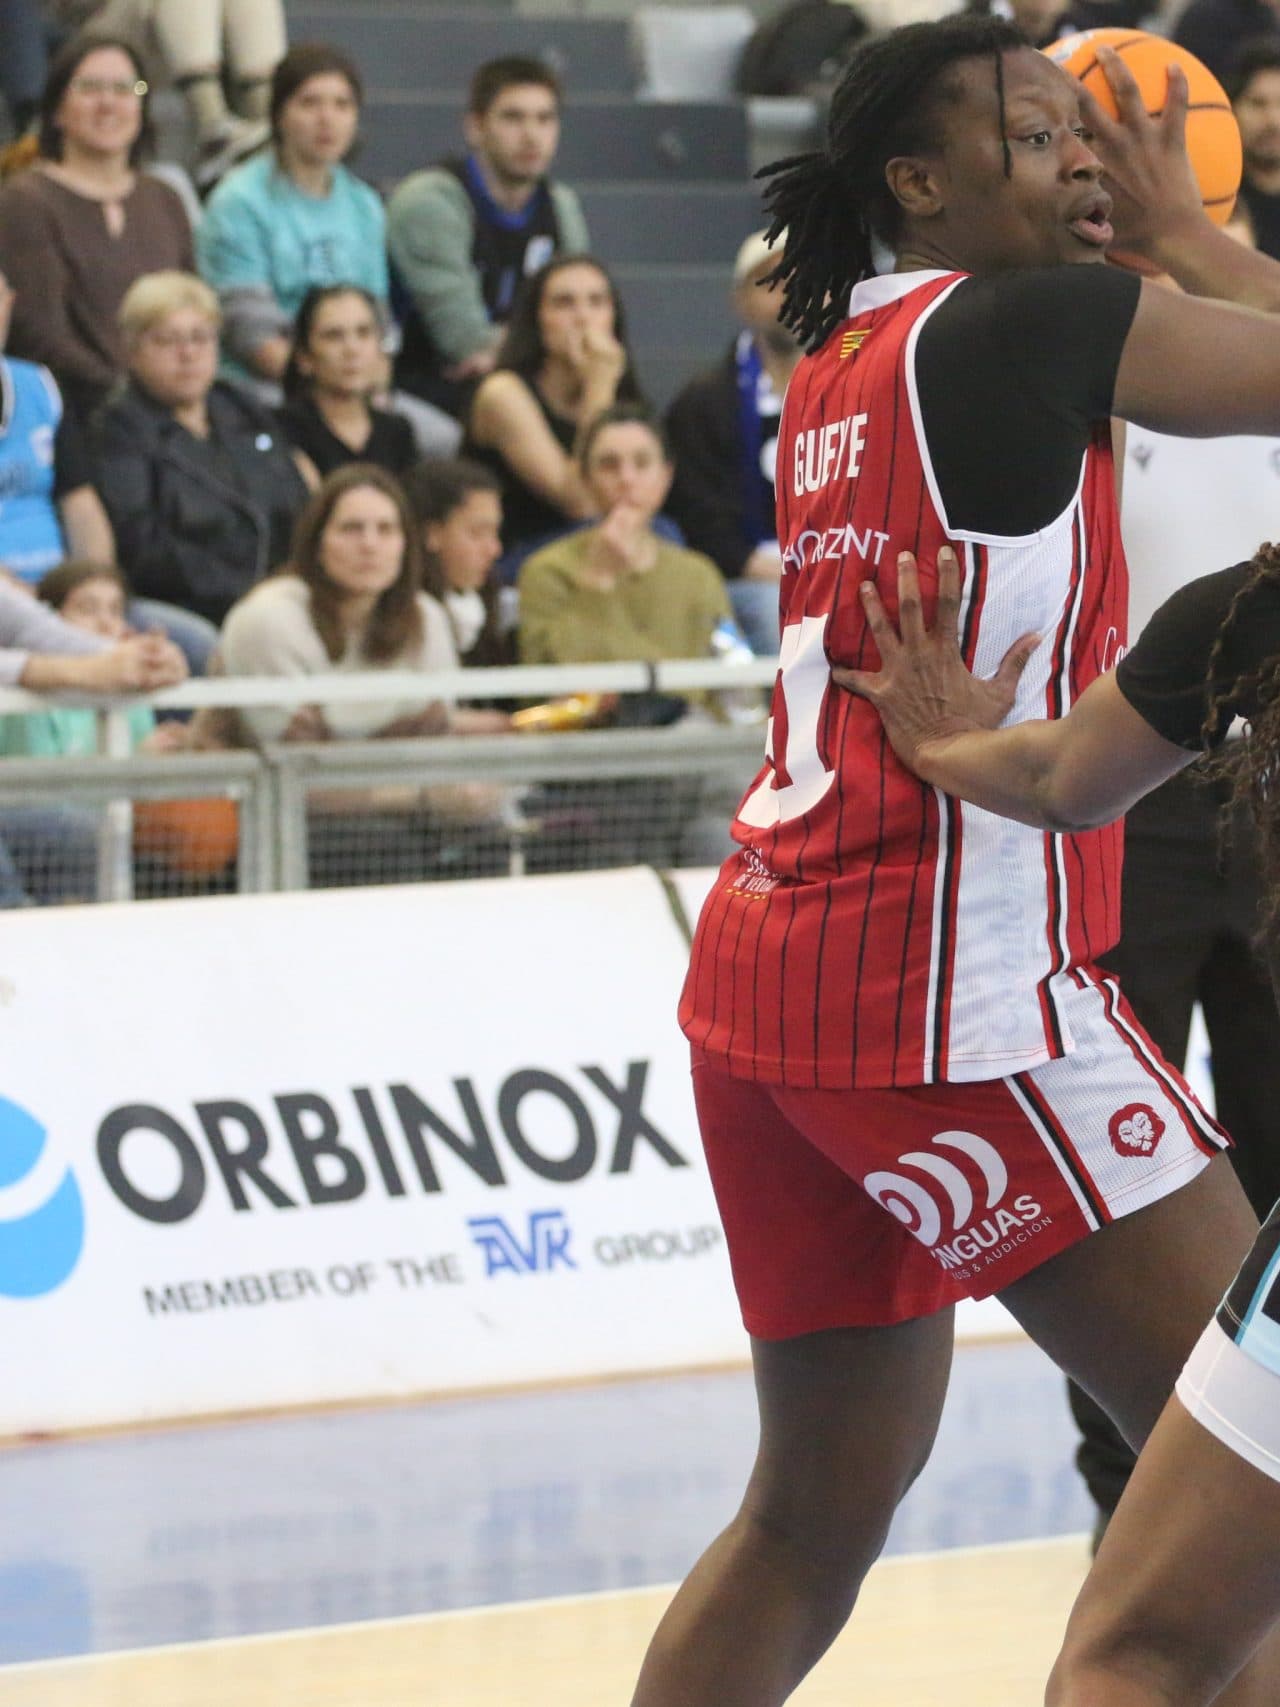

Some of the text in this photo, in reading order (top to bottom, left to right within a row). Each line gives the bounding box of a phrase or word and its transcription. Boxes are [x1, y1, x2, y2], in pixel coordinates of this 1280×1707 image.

[794, 413, 868, 497] GUEYE
[96, 1059, 692, 1225] ORBINOX
[142, 1266, 320, 1318] MEMBER
[327, 1262, 378, 1297] OF
[390, 1254, 465, 1287] THE
[593, 1225, 722, 1267] GROUP
